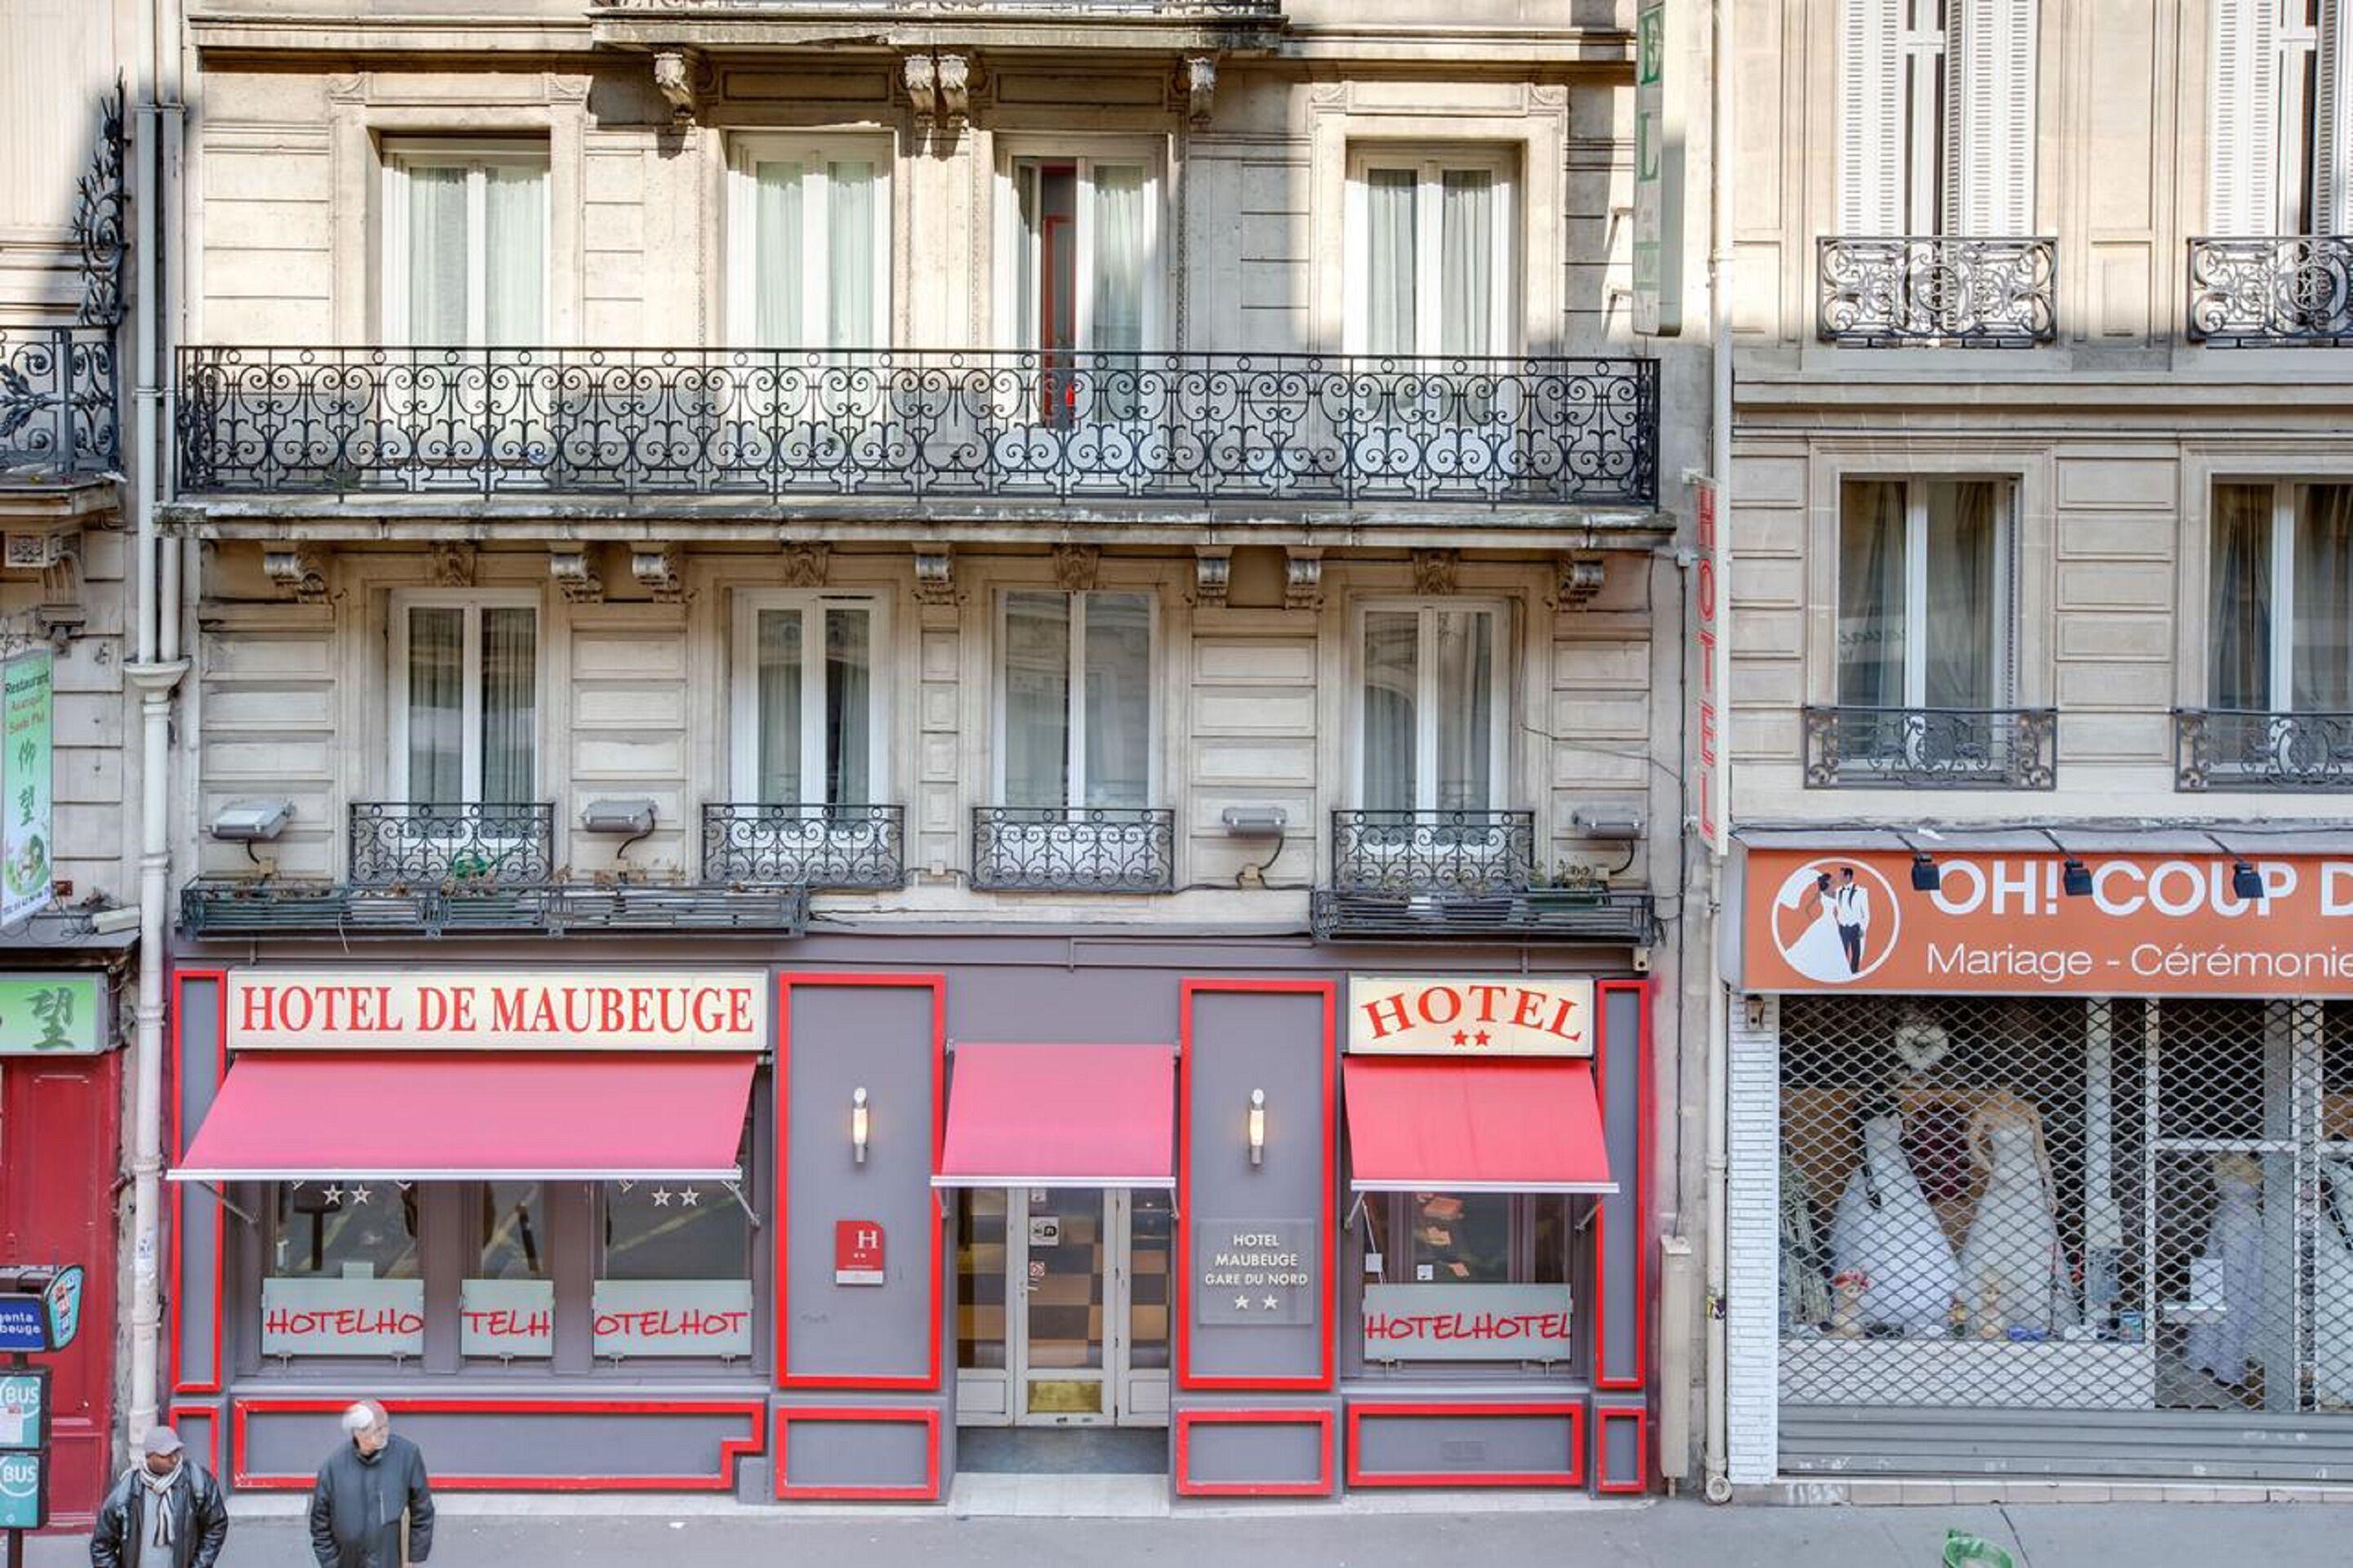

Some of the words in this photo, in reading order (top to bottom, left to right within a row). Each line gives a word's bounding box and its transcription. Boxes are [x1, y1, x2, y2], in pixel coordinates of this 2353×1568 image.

[1931, 860, 2058, 916] OH!
[2092, 860, 2297, 916] COUP
[1927, 942, 2093, 983] Mariage
[2131, 943, 2353, 977] Cérémonie
[240, 986, 404, 1032] HOTEL
[417, 986, 476, 1032] DE
[489, 986, 754, 1034] MAUBEUGE
[1360, 985, 1582, 1043] HOTEL
[857, 1229, 878, 1249] H
[1233, 1235, 1280, 1247] HOTEL
[1214, 1253, 1298, 1266] MAUBEUGE
[1205, 1273, 1241, 1285] GARE
[1244, 1273, 1264, 1285] DU
[1268, 1273, 1308, 1286] NORD
[266, 1307, 424, 1334] HOTELHO
[464, 1310, 550, 1335] TELH
[594, 1310, 748, 1335] OTELHOT
[1364, 1312, 1571, 1340] HOTELHOTEL
[5, 1386, 38, 1404] BUS
[3, 1465, 36, 1482] BUS
